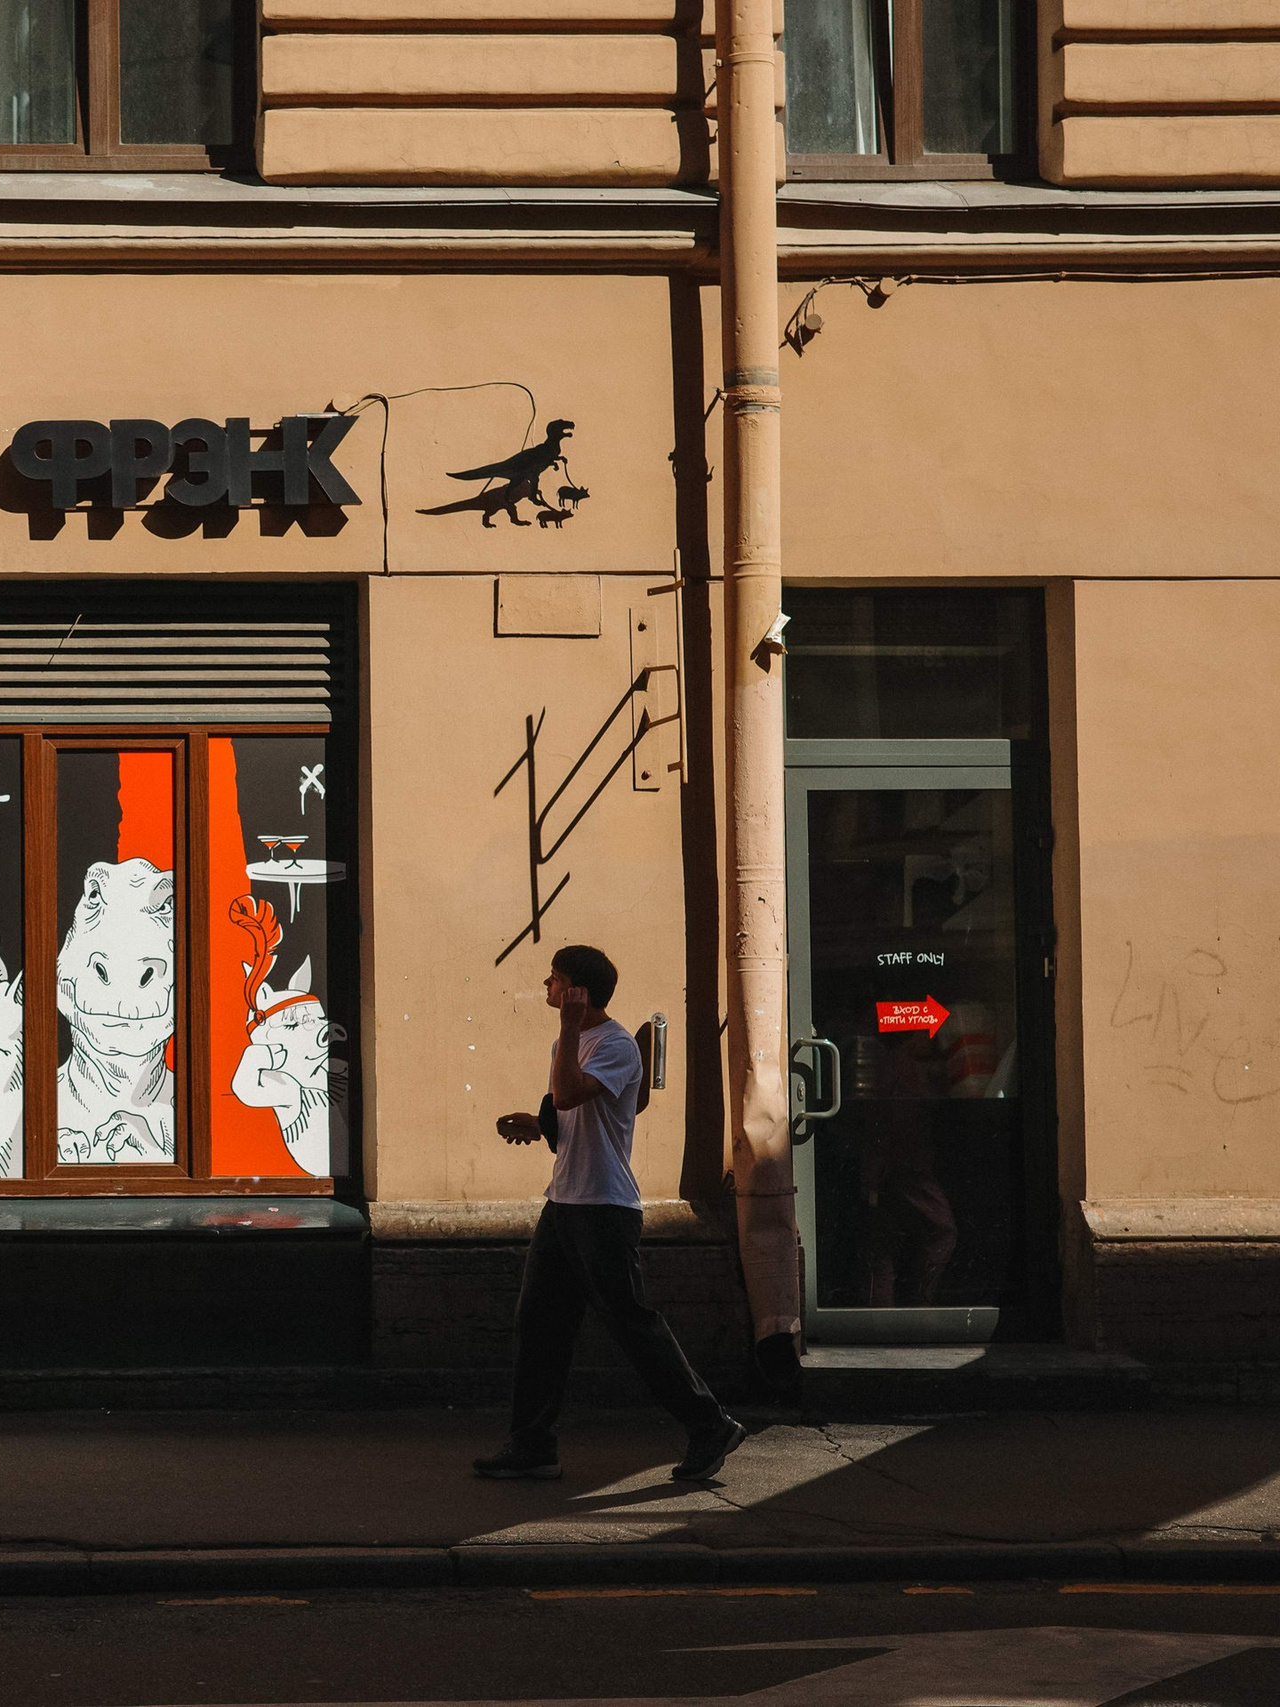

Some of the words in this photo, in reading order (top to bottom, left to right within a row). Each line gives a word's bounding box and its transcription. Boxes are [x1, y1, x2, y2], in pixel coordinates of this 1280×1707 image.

[11, 415, 363, 508] ФРЭНК
[877, 952, 913, 966] STAFF
[917, 952, 945, 966] ONLY
